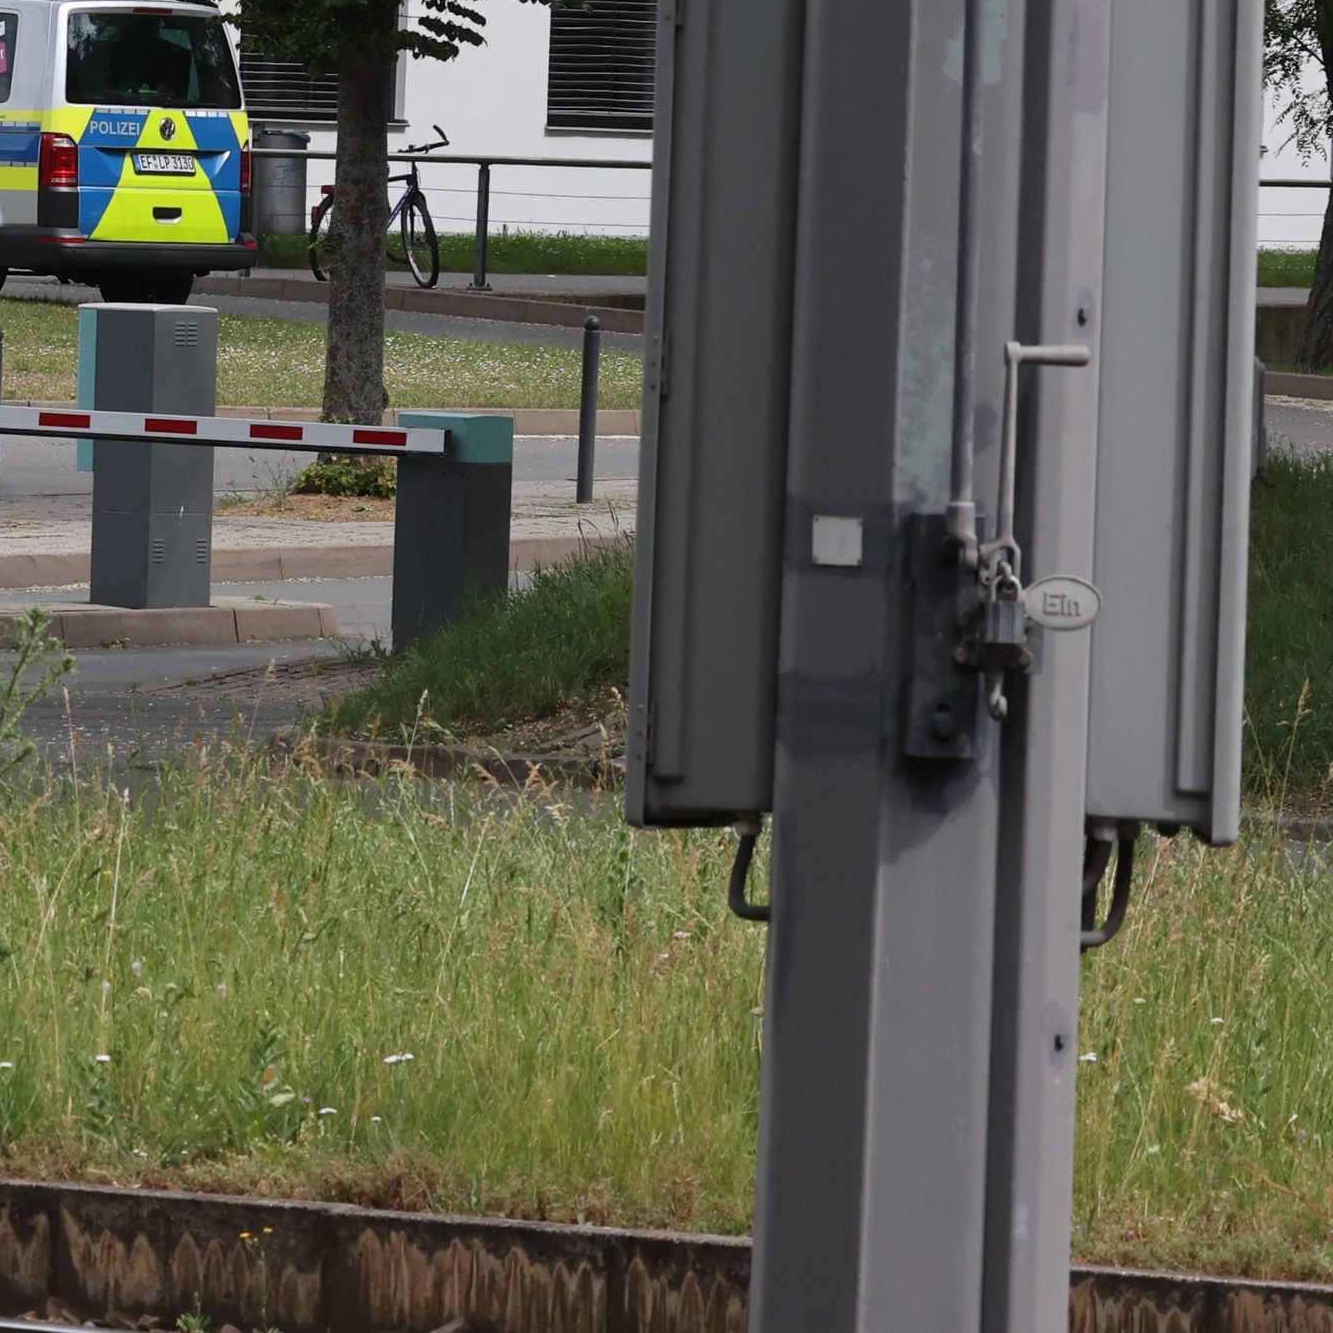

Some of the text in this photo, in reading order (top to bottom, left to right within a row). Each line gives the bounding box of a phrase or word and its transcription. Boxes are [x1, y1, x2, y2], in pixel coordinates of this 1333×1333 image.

[90, 120, 140, 136] POLIZEI
[140, 155, 194, 171] EF LP 3130
[1043, 592, 1081, 617] Ein
